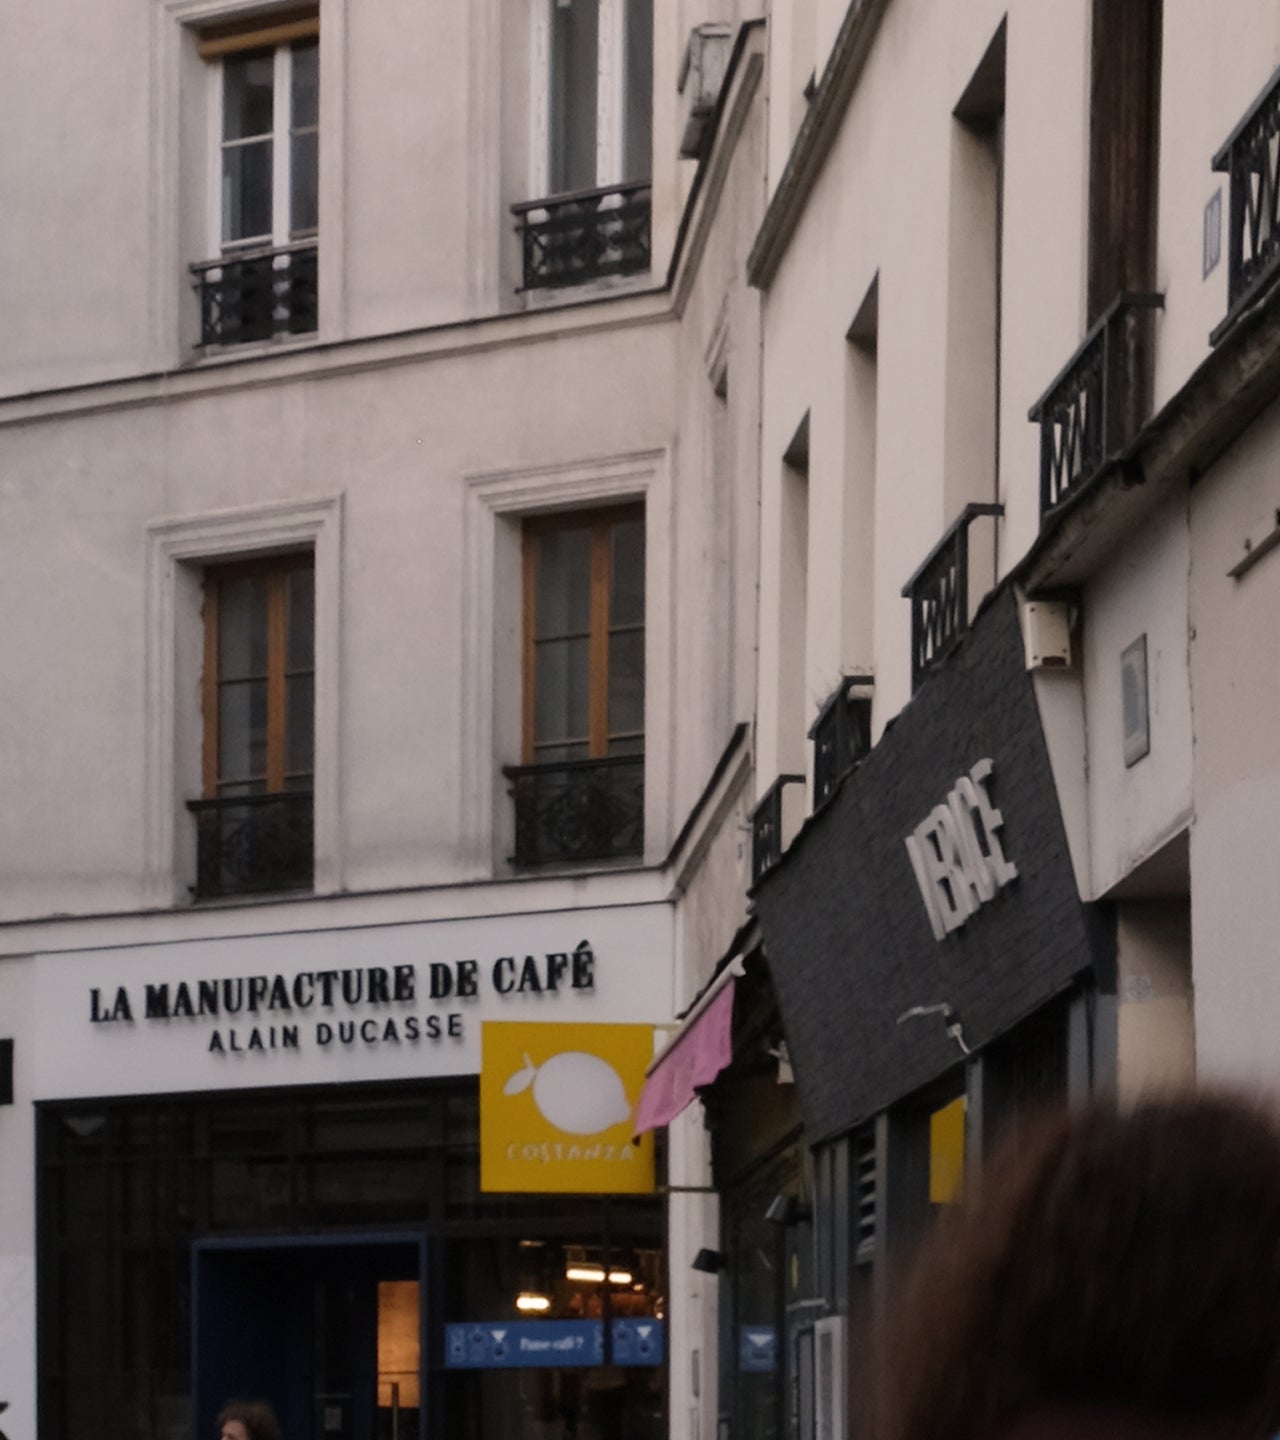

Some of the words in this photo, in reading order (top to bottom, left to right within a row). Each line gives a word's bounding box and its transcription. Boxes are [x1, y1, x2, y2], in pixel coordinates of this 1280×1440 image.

[89, 986, 133, 1023] LA
[144, 963, 416, 1019] MANUFACTURE
[429, 959, 478, 999] DE
[491, 939, 594, 994] CAFÉ
[208, 1024, 298, 1052] ALAIN
[316, 1013, 462, 1046] DUCASSE
